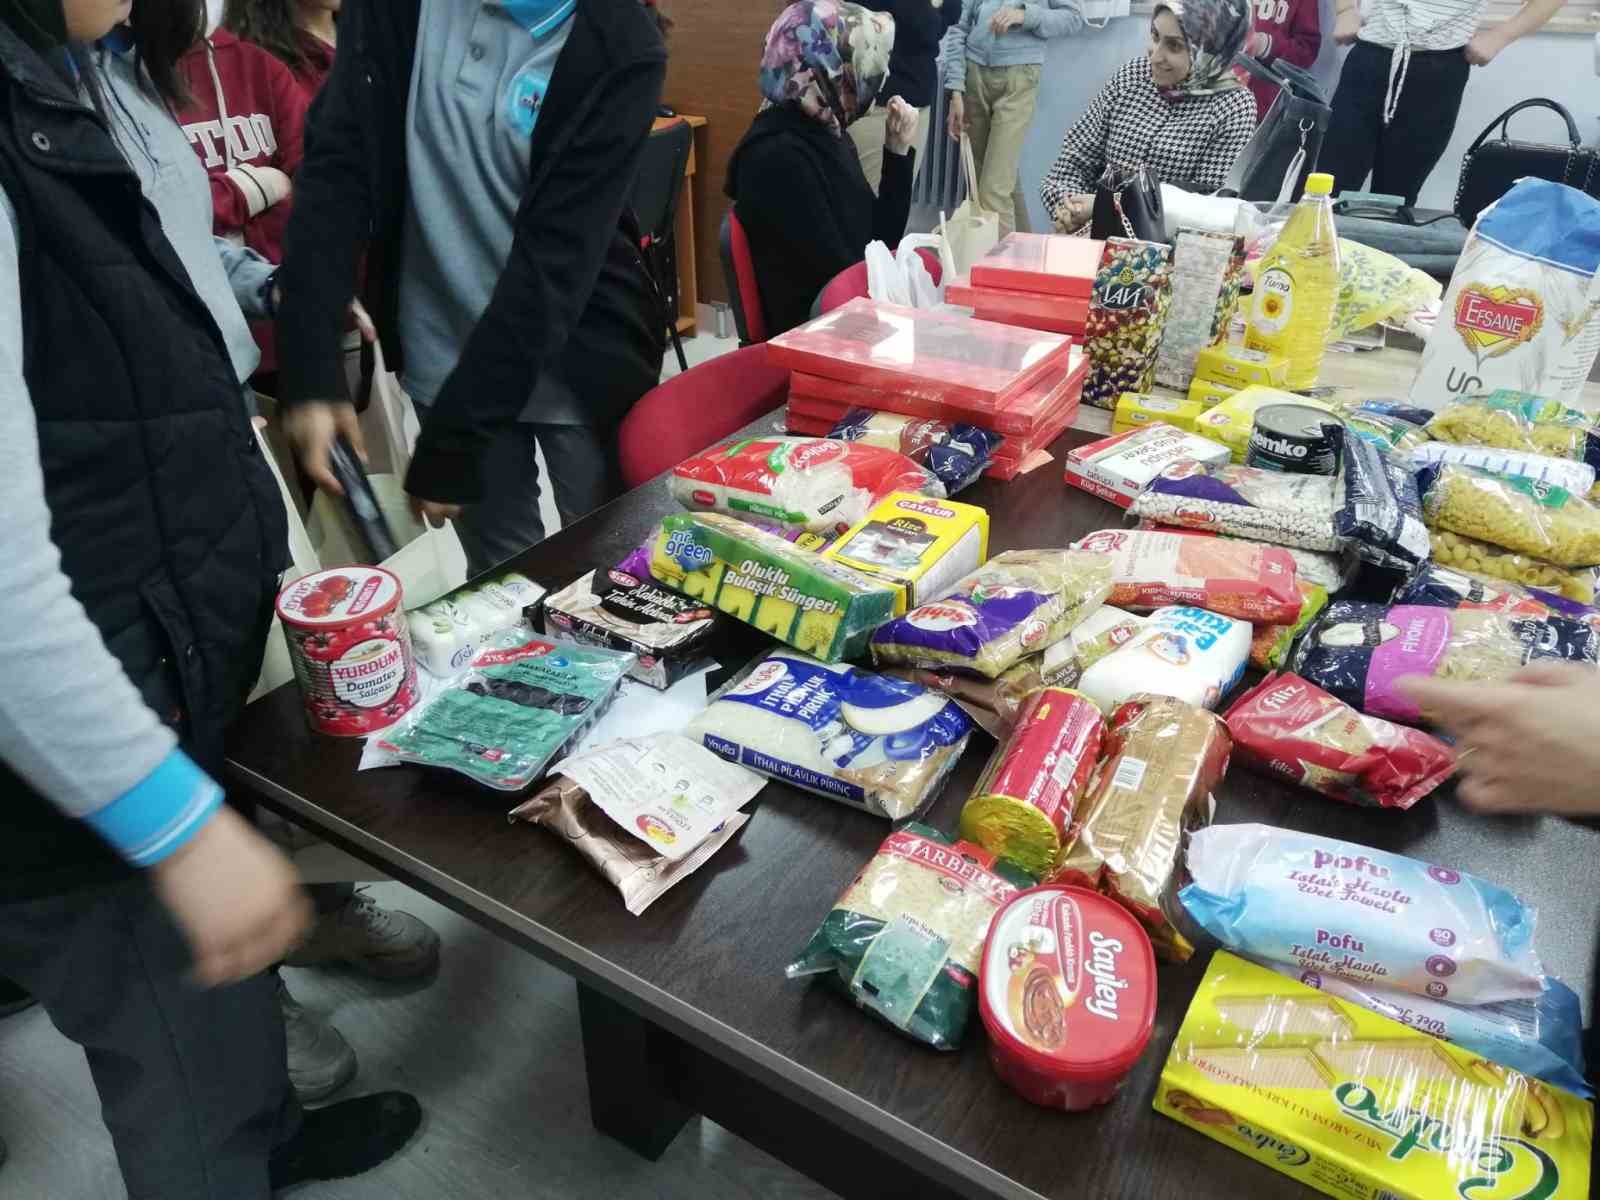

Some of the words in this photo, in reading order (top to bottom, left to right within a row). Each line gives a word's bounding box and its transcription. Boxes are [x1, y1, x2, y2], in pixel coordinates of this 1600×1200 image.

[1465, 299, 1525, 335] EFSANE
[664, 539, 714, 563] green
[740, 559, 791, 585] Oluklu
[723, 570, 778, 599] Bulaşık
[778, 584, 839, 615] Süngeri
[335, 650, 399, 681] YURDUM
[346, 669, 397, 693] Domates
[1264, 682, 1307, 711] filiz
[753, 754, 779, 775] İTHAL
[779, 763, 819, 786] PİLAVLIK
[1297, 882, 1336, 901] Wet
[1290, 944, 1333, 966] Islak
[1316, 929, 1366, 954] Pofu
[1083, 930, 1129, 1021] Sayley
